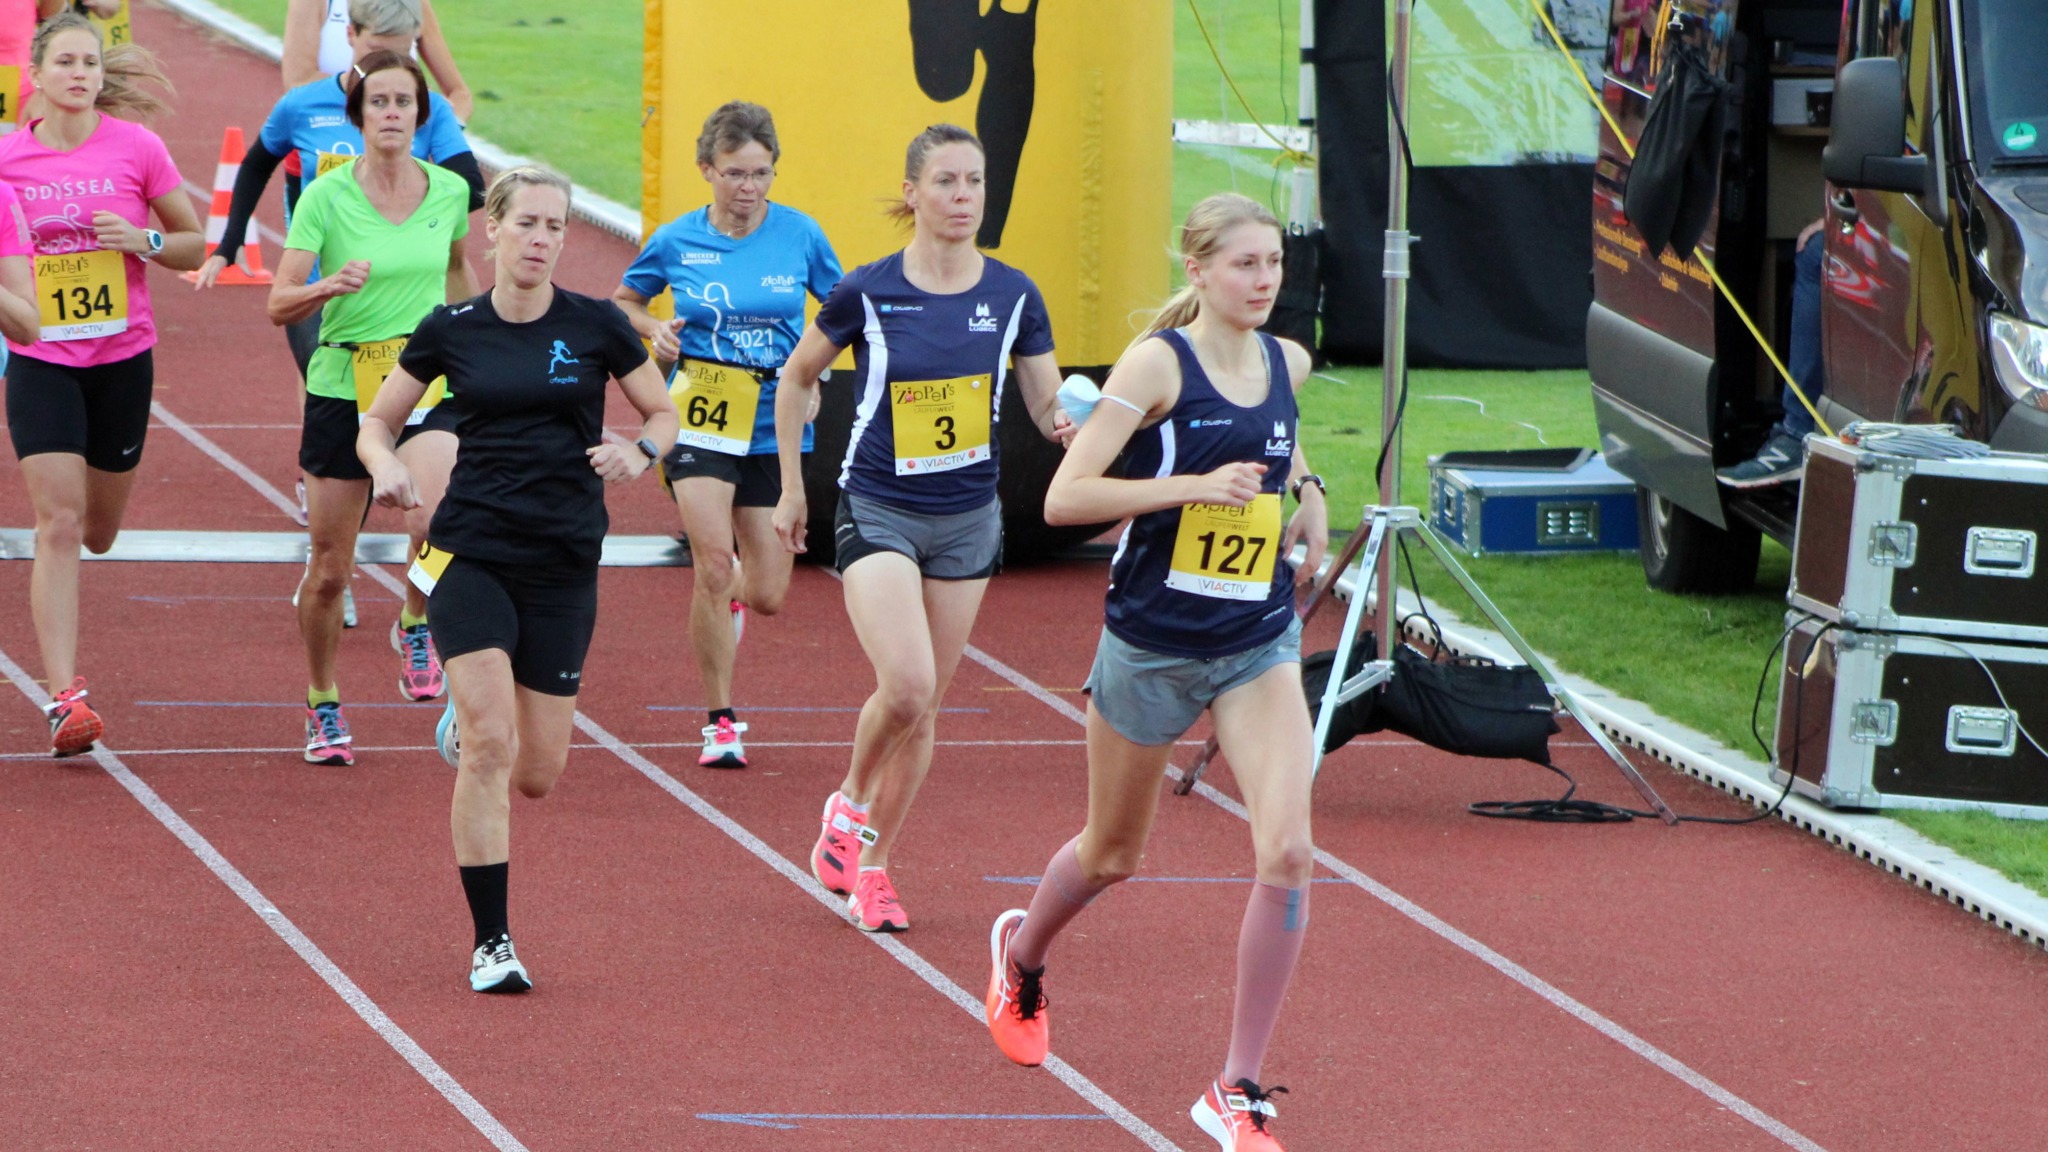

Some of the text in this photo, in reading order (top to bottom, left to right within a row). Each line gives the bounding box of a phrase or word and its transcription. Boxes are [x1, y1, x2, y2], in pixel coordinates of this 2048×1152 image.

[25, 177, 115, 201] ODYSSEA
[51, 285, 113, 321] 134
[968, 318, 998, 327] LAC
[729, 328, 773, 349] 2021
[687, 395, 728, 432] 64
[934, 416, 957, 450] 3
[1266, 439, 1291, 451] LAC
[924, 453, 966, 468] VIACTIV
[1197, 531, 1267, 576] 127
[1202, 579, 1248, 594] VIACTIV
